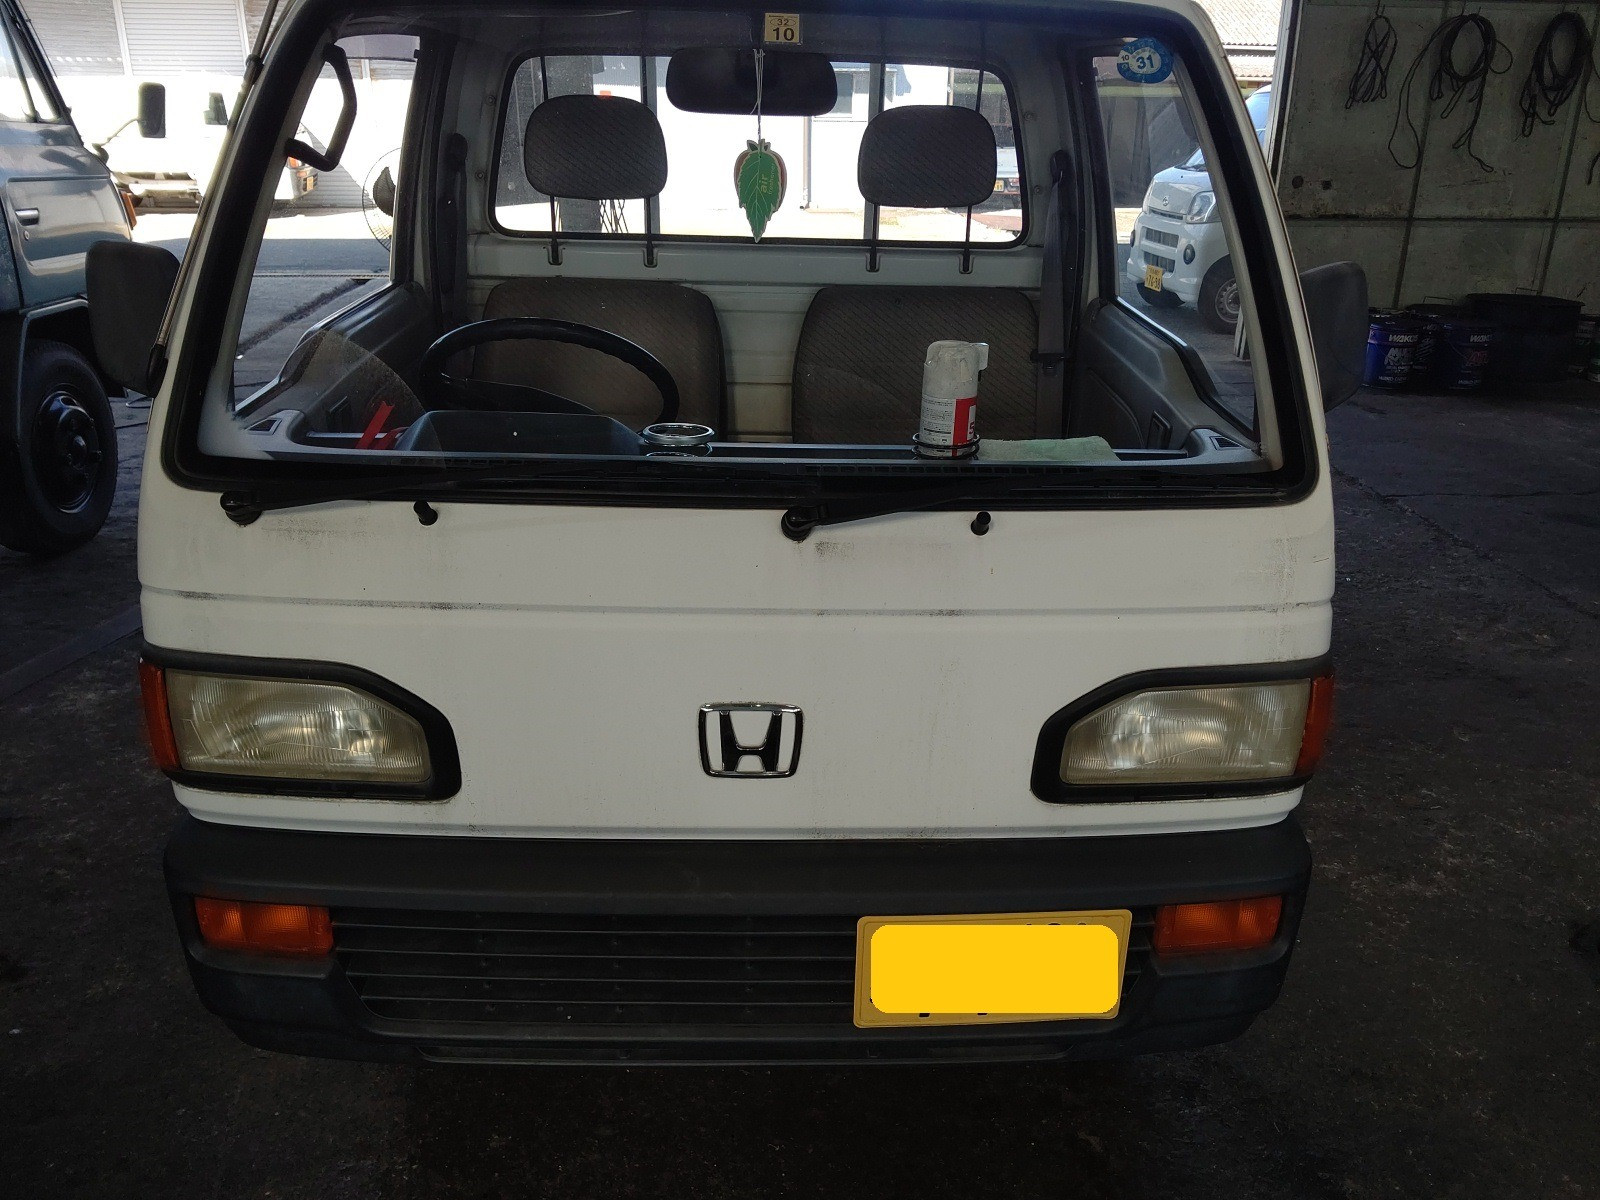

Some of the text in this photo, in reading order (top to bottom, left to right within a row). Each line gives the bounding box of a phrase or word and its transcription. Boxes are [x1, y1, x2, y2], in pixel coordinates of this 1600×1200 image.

[777, 18, 789, 26] 32
[772, 27, 795, 41] 10
[1136, 54, 1155, 70] 31
[759, 174, 768, 193] air
